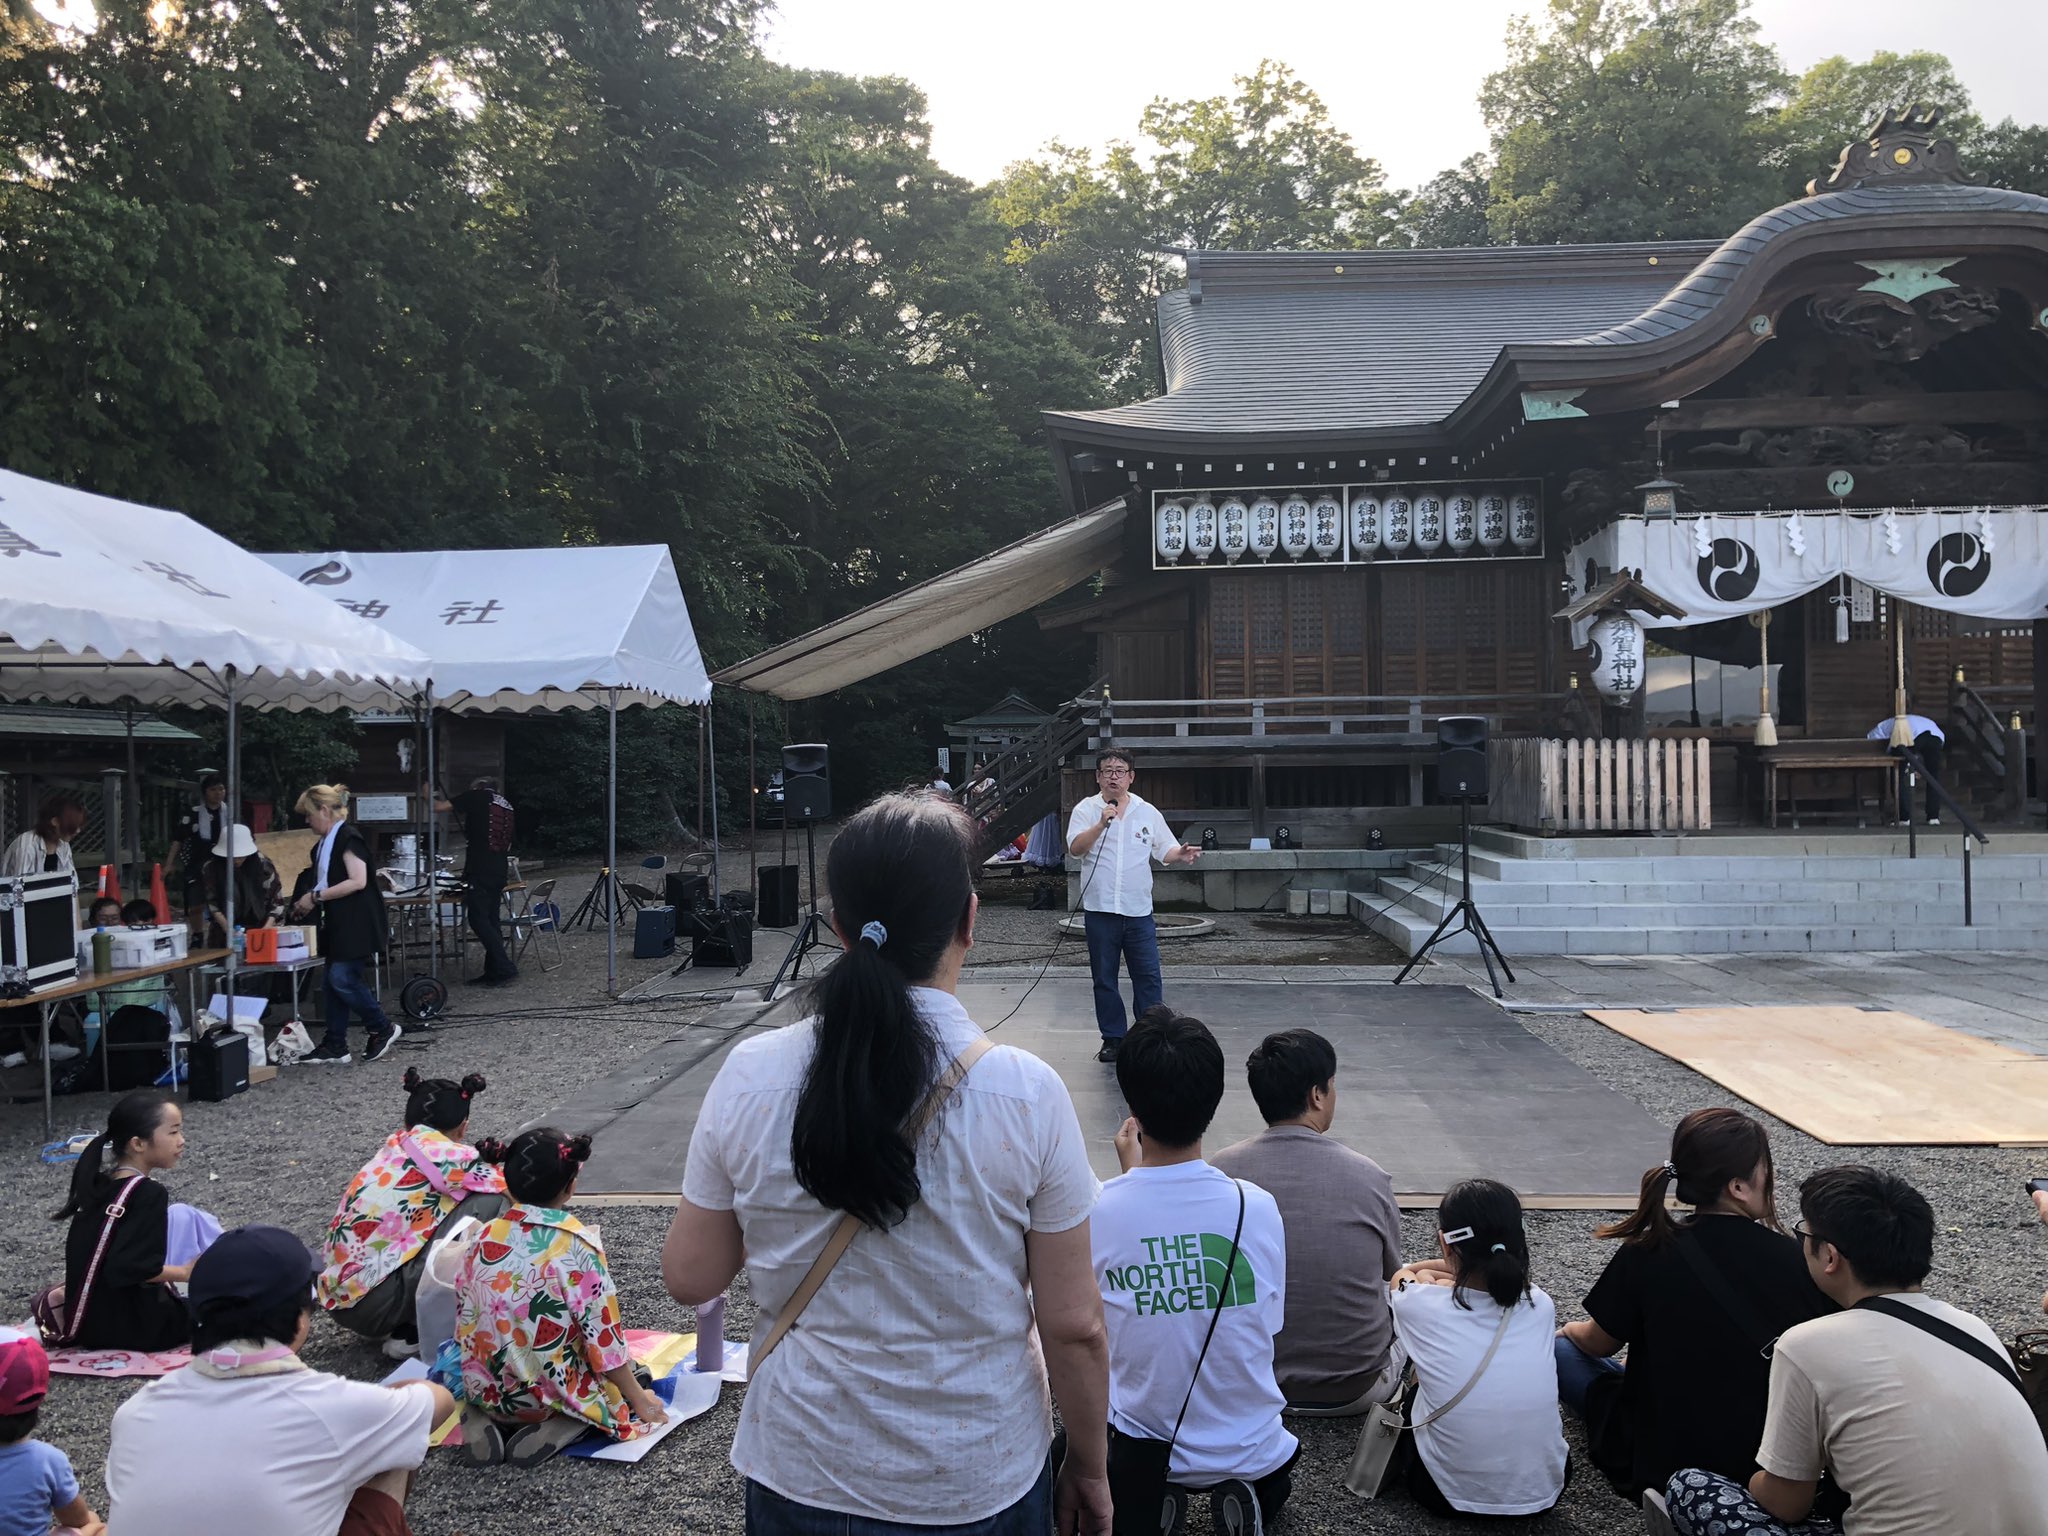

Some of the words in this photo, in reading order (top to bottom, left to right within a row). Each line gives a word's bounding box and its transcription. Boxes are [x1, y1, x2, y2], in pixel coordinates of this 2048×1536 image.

[1609, 620, 1637, 691] 須賀神社
[1140, 1233, 1200, 1262] THE
[1105, 1259, 1203, 1291] NORTH
[1134, 1286, 1205, 1316] FACE
